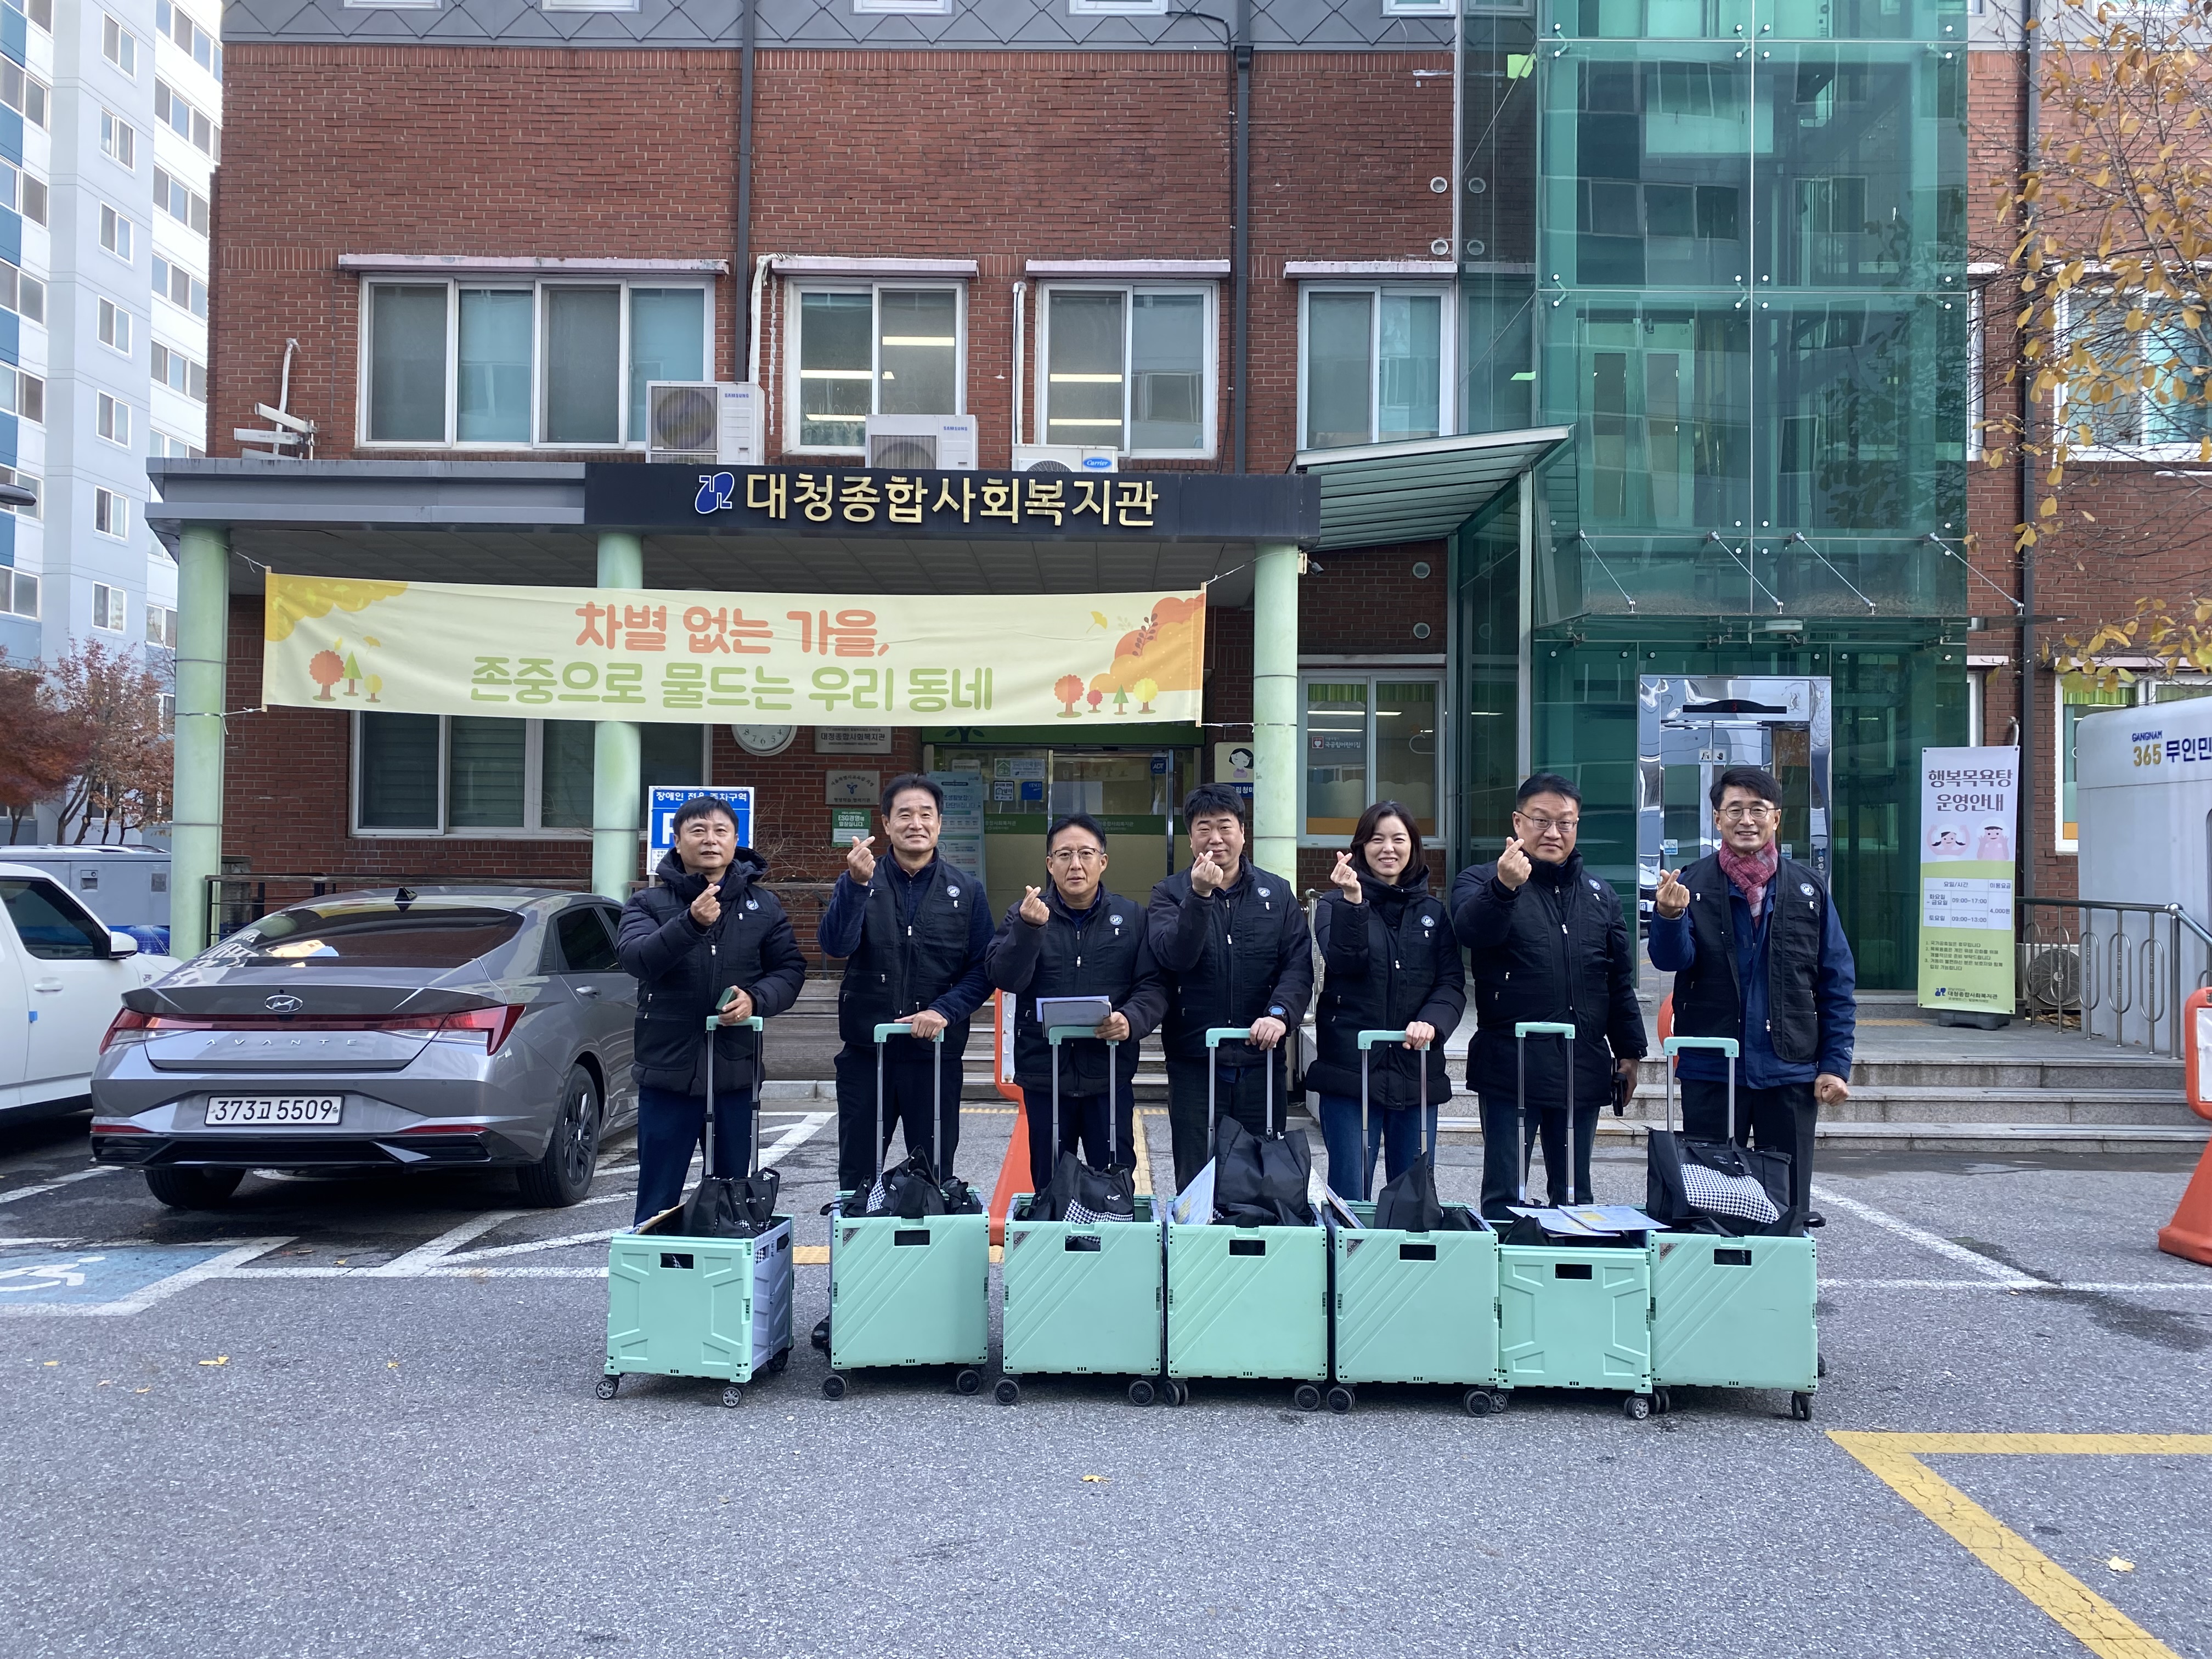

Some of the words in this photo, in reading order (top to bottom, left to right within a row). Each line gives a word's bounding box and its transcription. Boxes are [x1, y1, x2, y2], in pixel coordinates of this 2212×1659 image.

[747, 472, 1159, 527] 대청종합사회복지관
[575, 601, 667, 651] 차별
[683, 606, 774, 654] 없는
[787, 610, 889, 657] 가을,
[471, 656, 646, 704] 존중으로
[661, 662, 795, 710] 물드는
[808, 667, 894, 712] 우리
[907, 667, 992, 712] 동네
[2132, 730, 2163, 742] GANGNAM
[2134, 743, 2162, 767] 365
[1928, 769, 2013, 787] 행복목욕탕
[656, 792, 684, 801] 장애인
[1936, 794, 2004, 812] 운영안내
[1948, 991, 1997, 1000] 대청종합사회복지관
[215, 1100, 272, 1121] 373고
[276, 1099, 333, 1120] 5509
